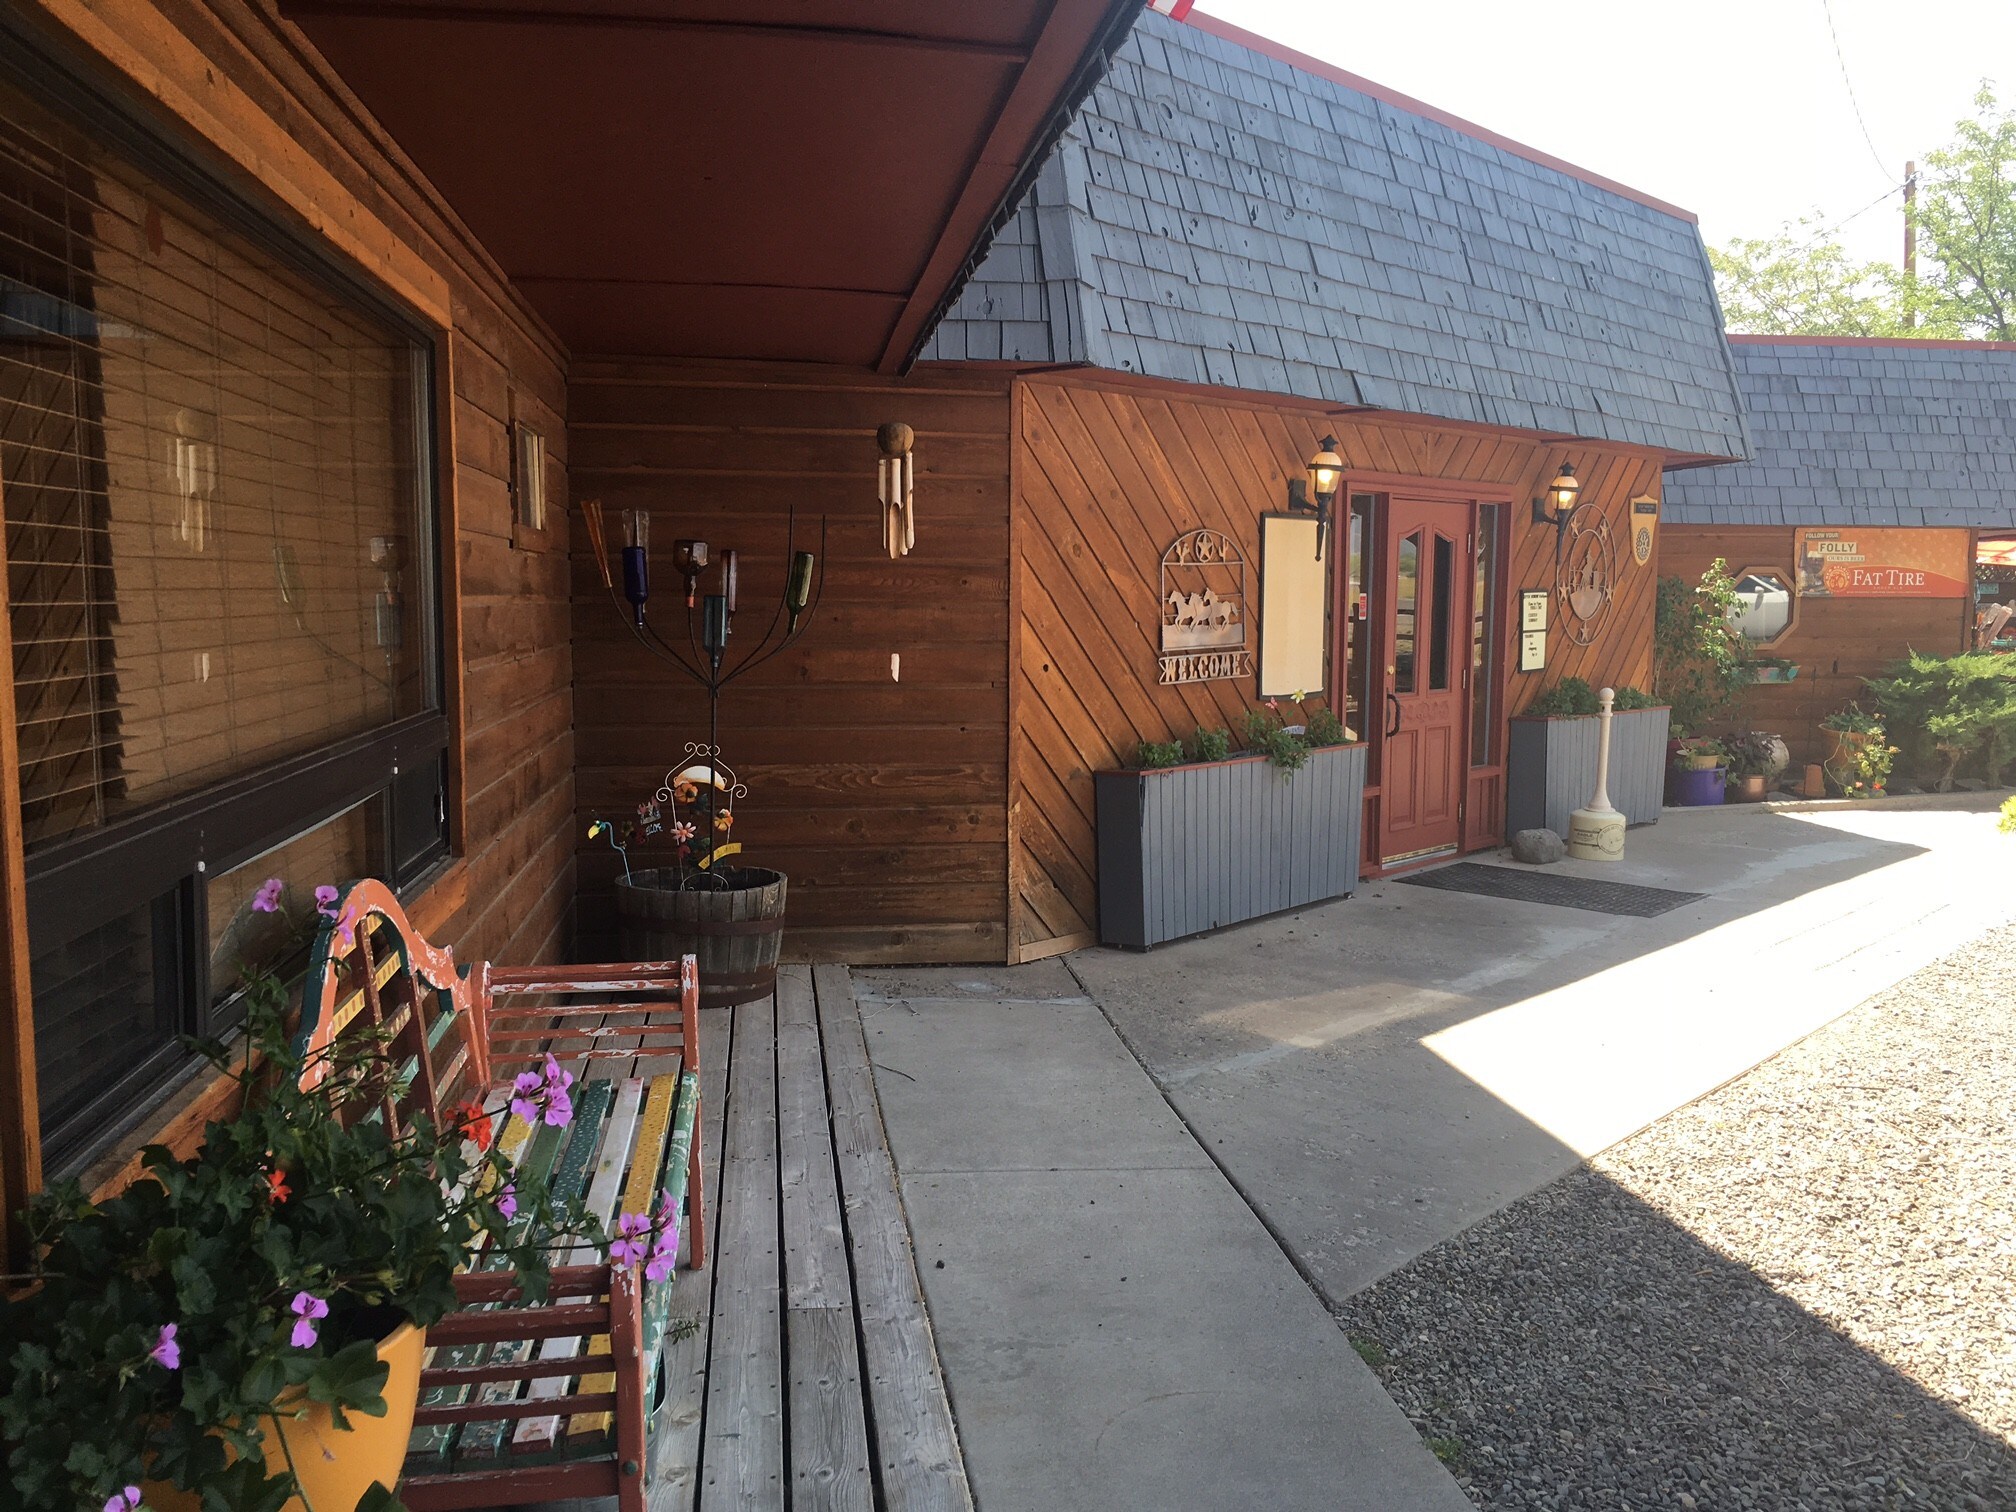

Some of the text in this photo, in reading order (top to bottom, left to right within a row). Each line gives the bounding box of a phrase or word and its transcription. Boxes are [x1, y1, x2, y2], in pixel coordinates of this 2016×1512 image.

[1820, 543, 1854, 552] FOLLY
[1852, 569, 1925, 586] FAT TIRE
[1164, 653, 1241, 682] WELCOME
